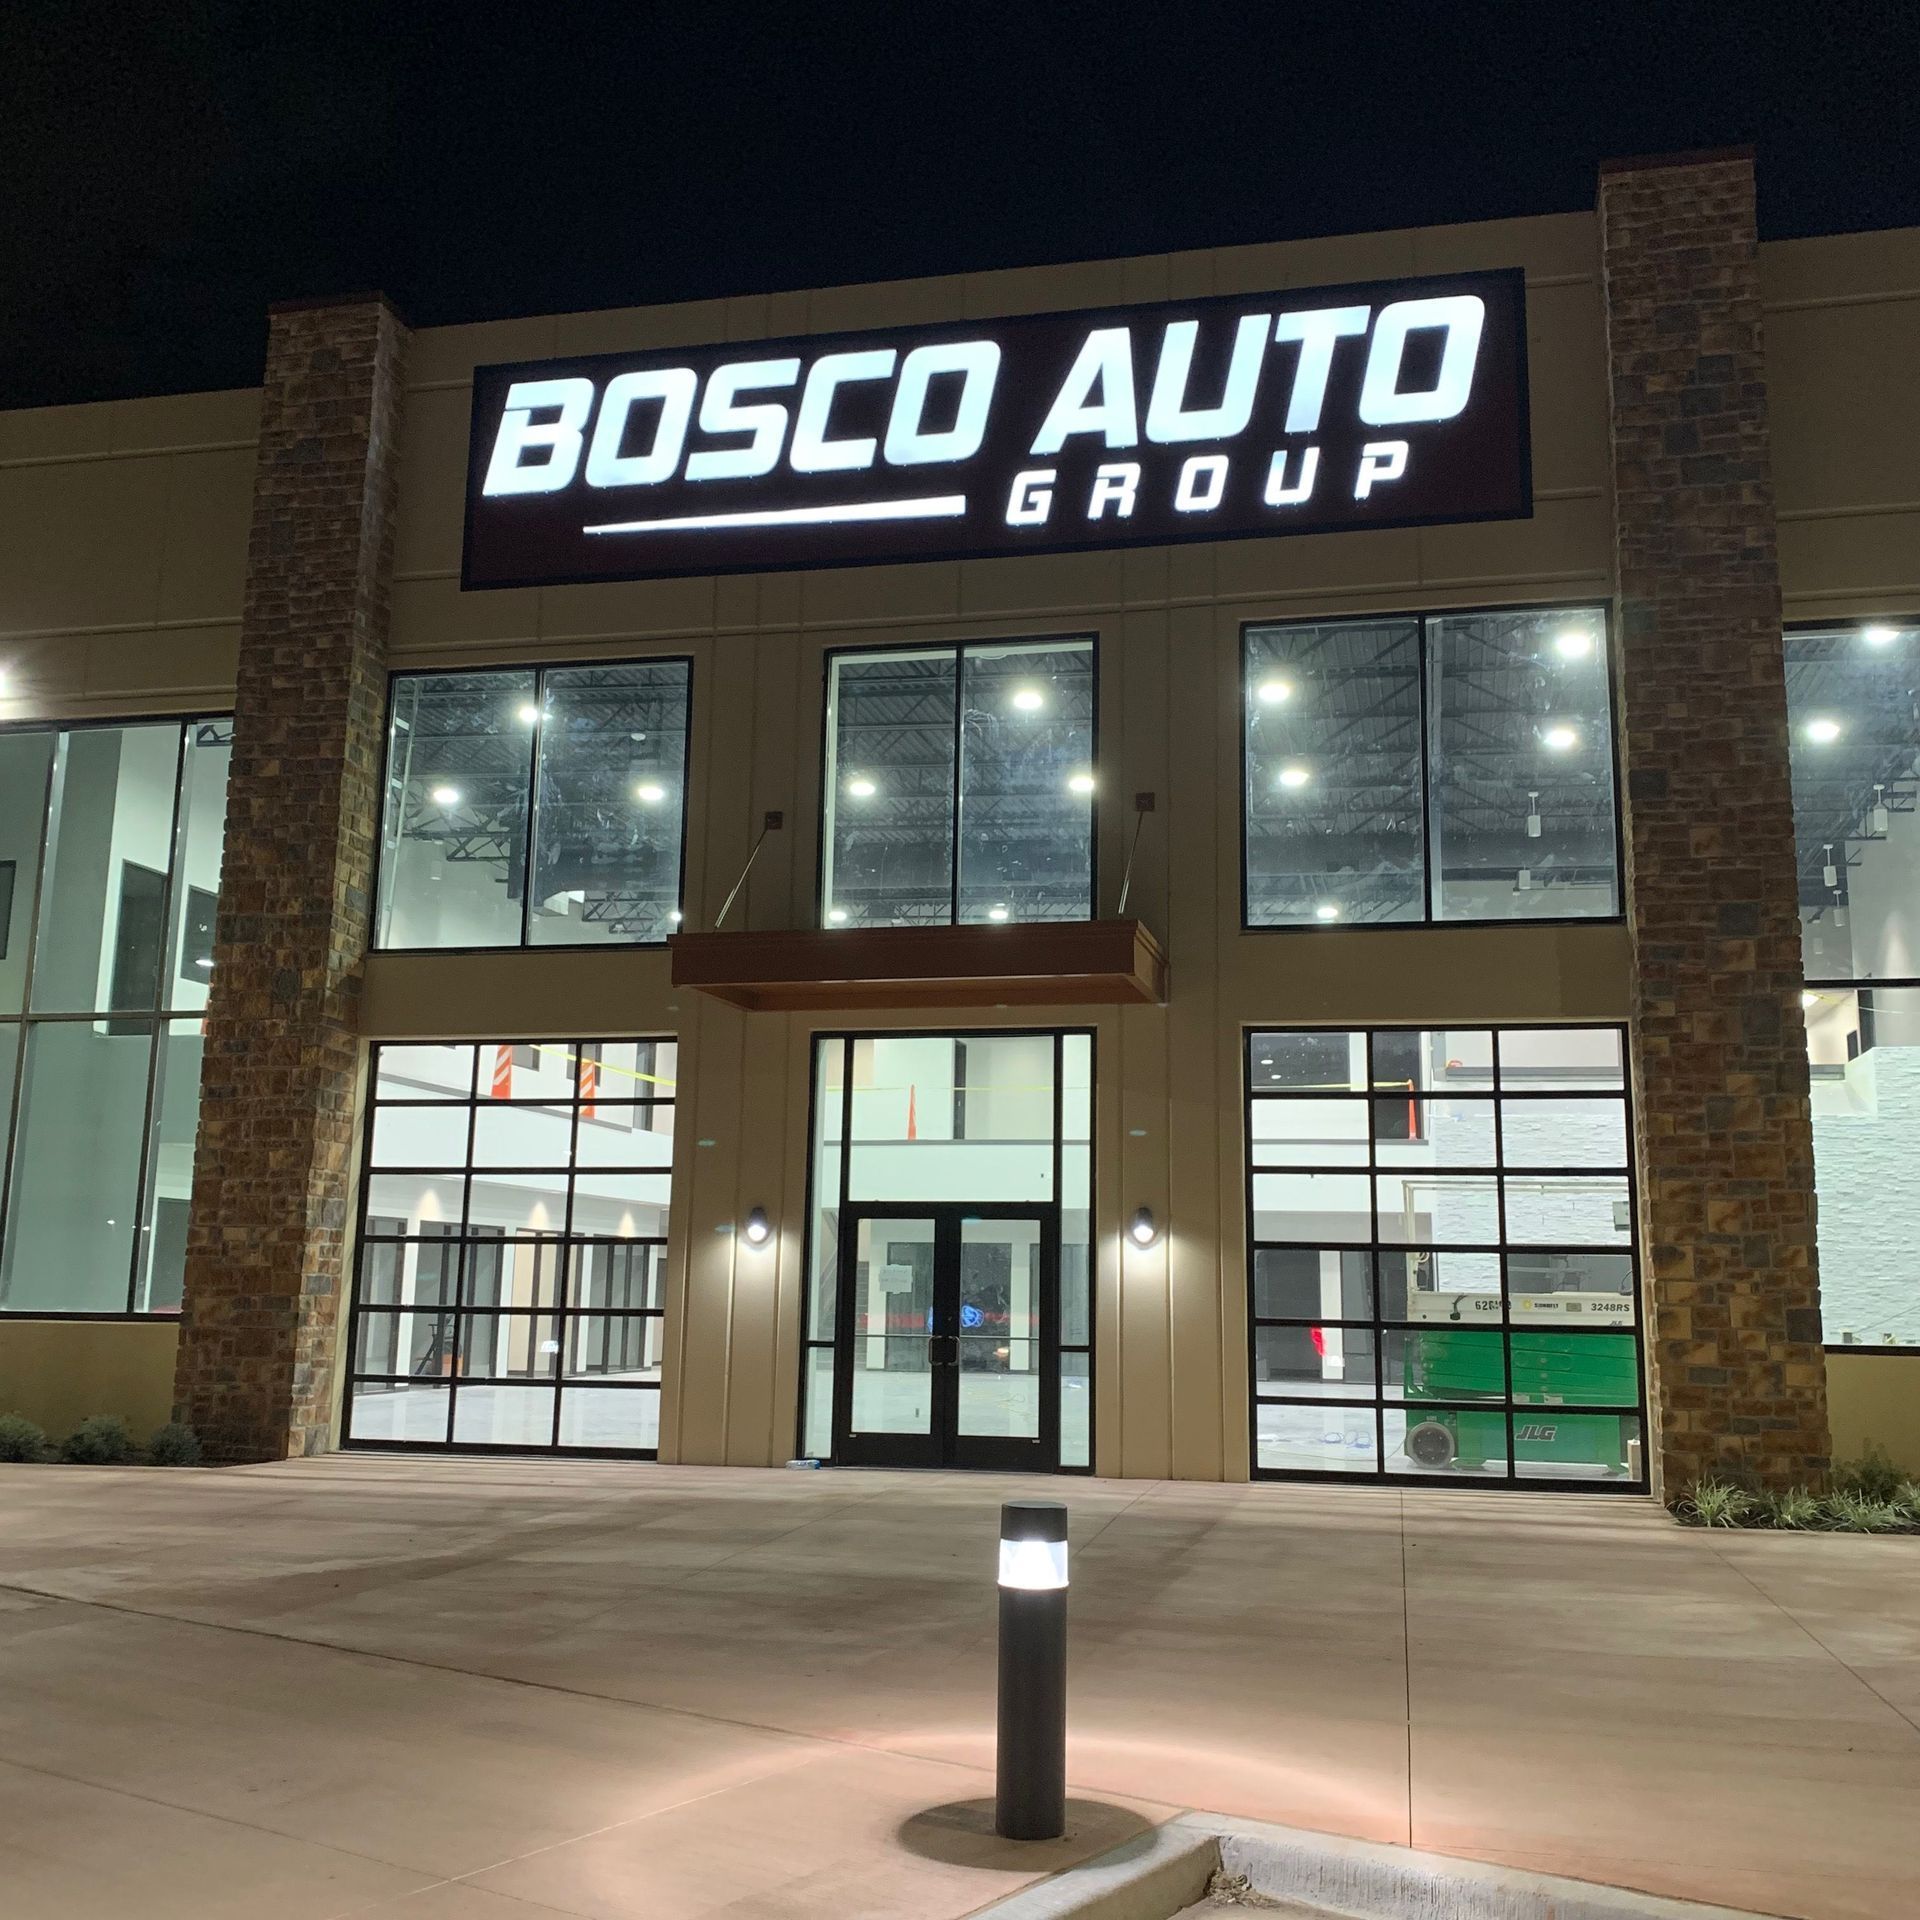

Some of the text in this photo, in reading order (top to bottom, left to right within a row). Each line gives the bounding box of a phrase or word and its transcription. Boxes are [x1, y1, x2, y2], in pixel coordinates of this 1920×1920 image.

[483, 296, 1484, 496] BOSCO AUTO
[1006, 441, 1408, 526] GROUP
[1591, 1303, 1630, 1312] 3248RS
[1514, 1425, 1557, 1441] JLG
